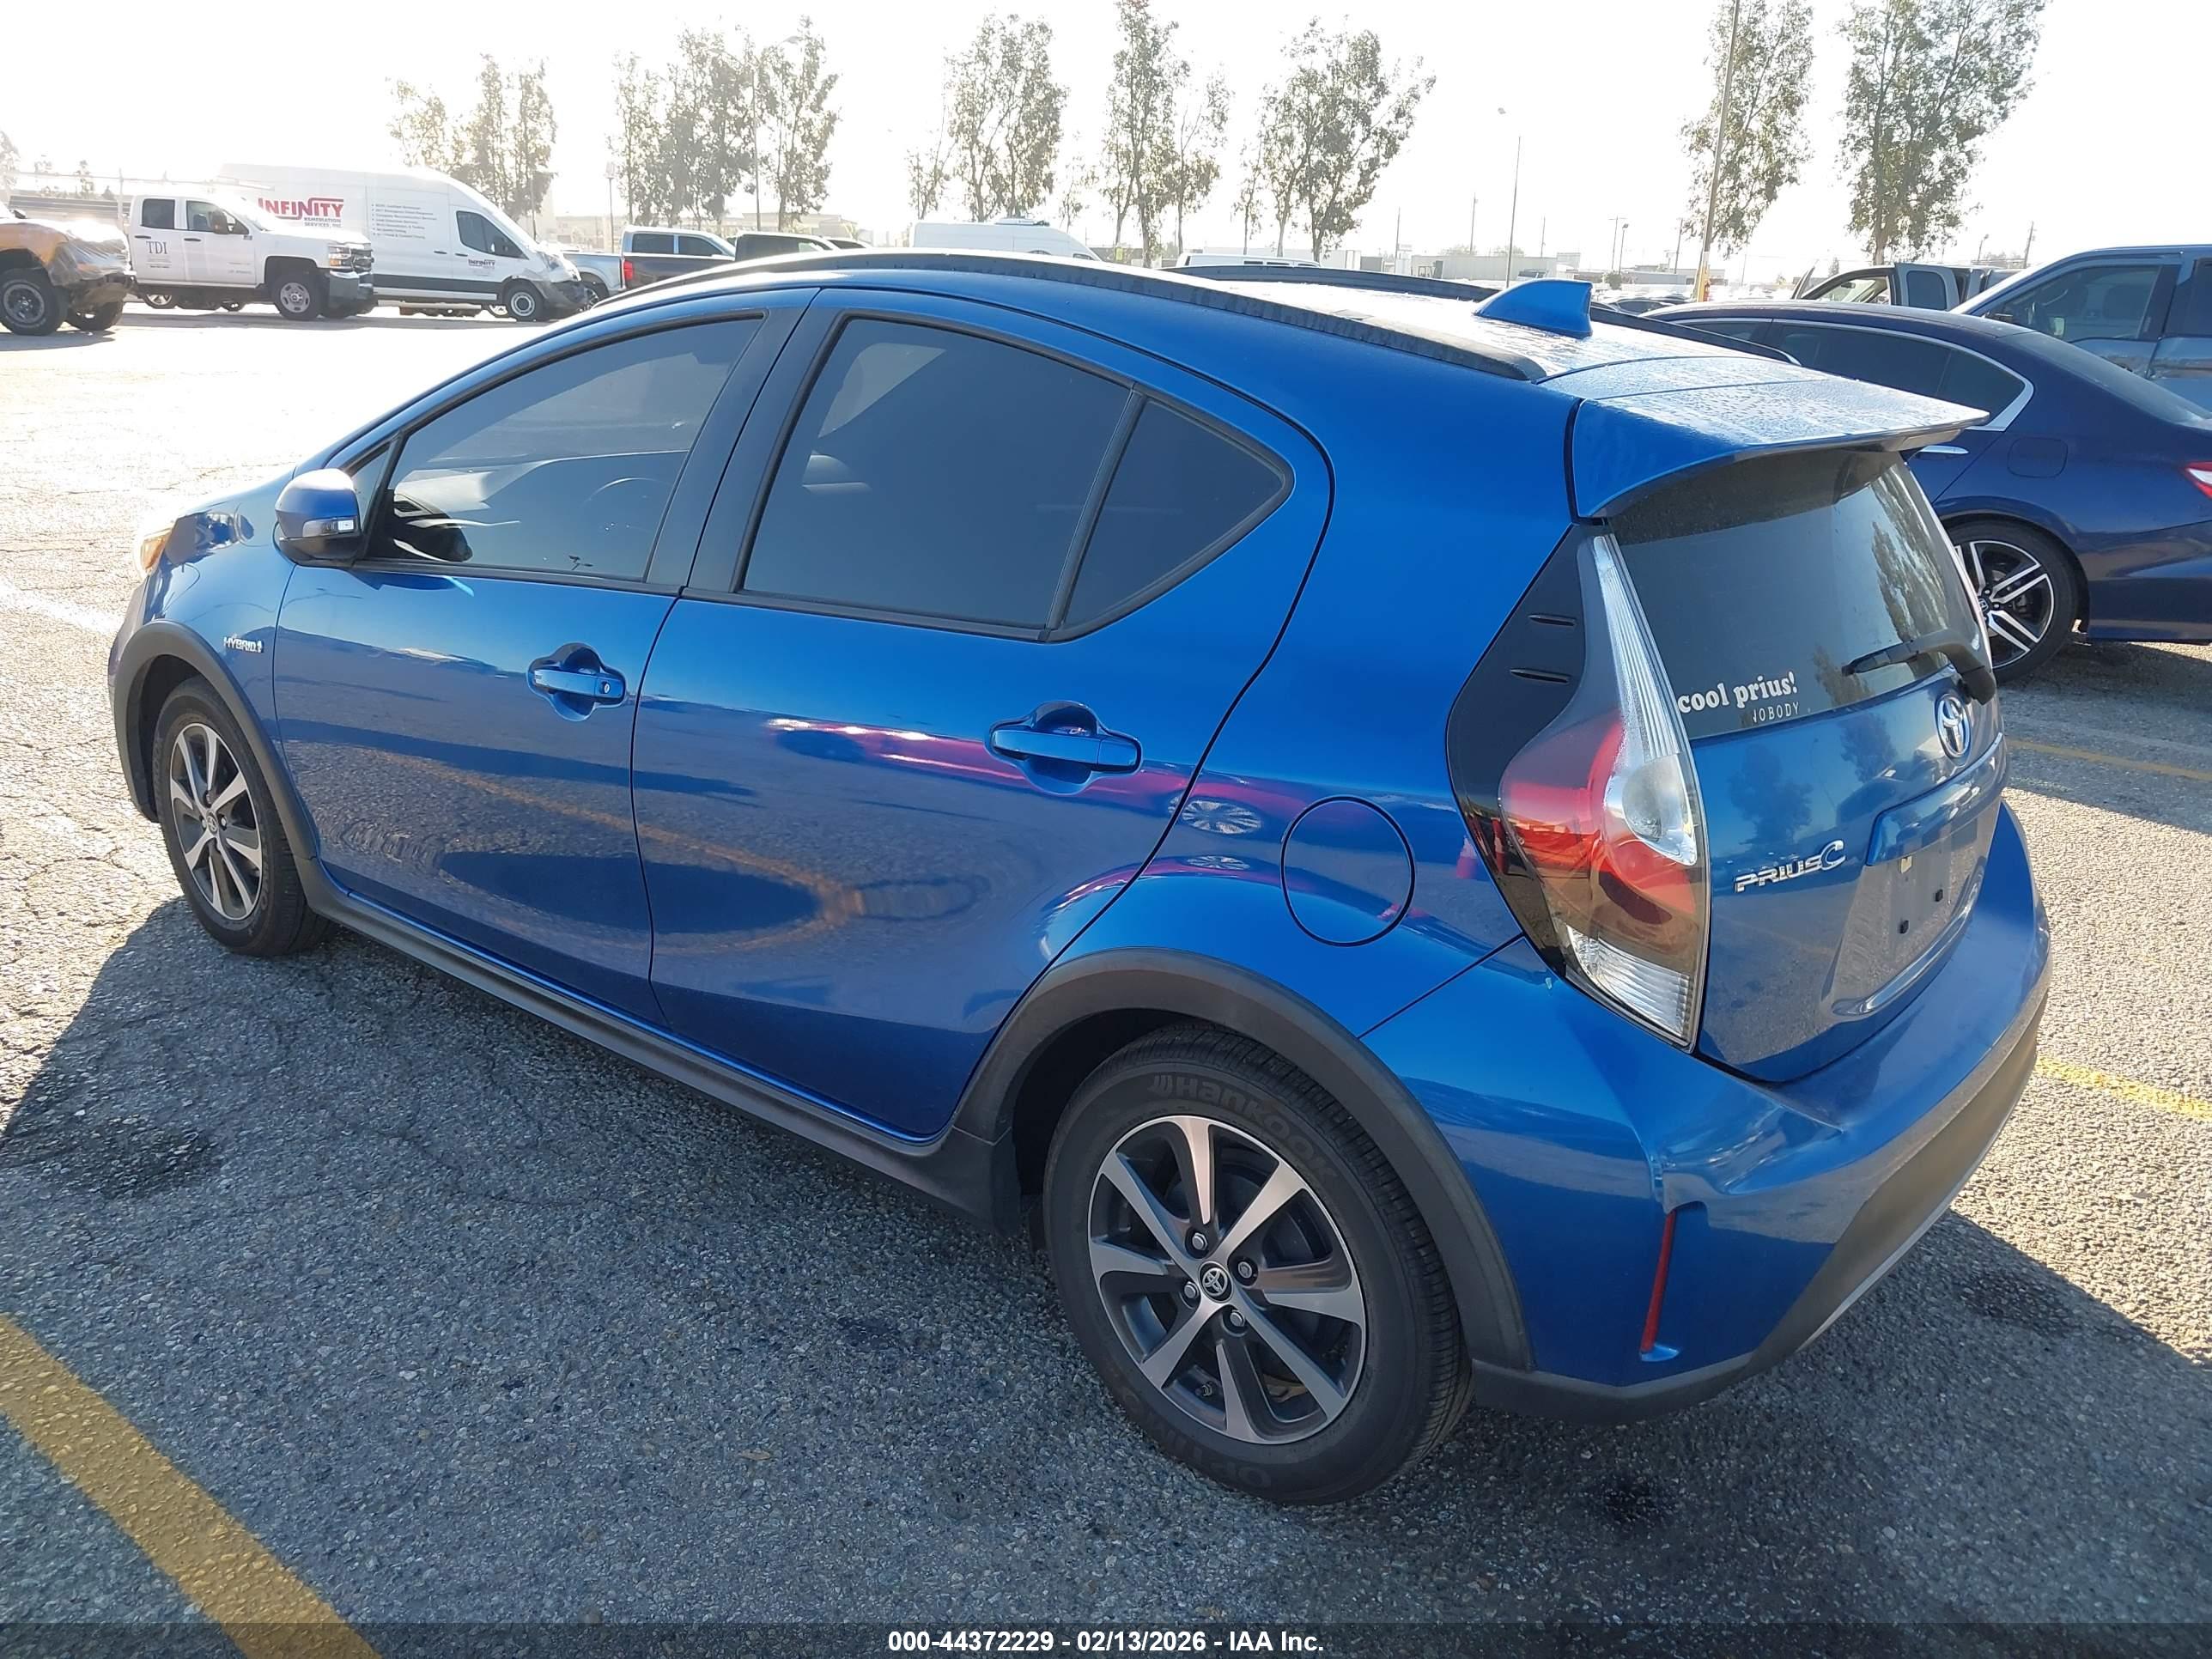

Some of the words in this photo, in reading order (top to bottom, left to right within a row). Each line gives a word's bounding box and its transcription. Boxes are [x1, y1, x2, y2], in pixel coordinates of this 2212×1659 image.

[258, 197, 343, 220] INFINITY
[146, 240, 167, 254] TDI
[223, 636, 257, 653] HYBRID
[1677, 683, 1729, 714] cool
[1733, 672, 1798, 709] prius!
